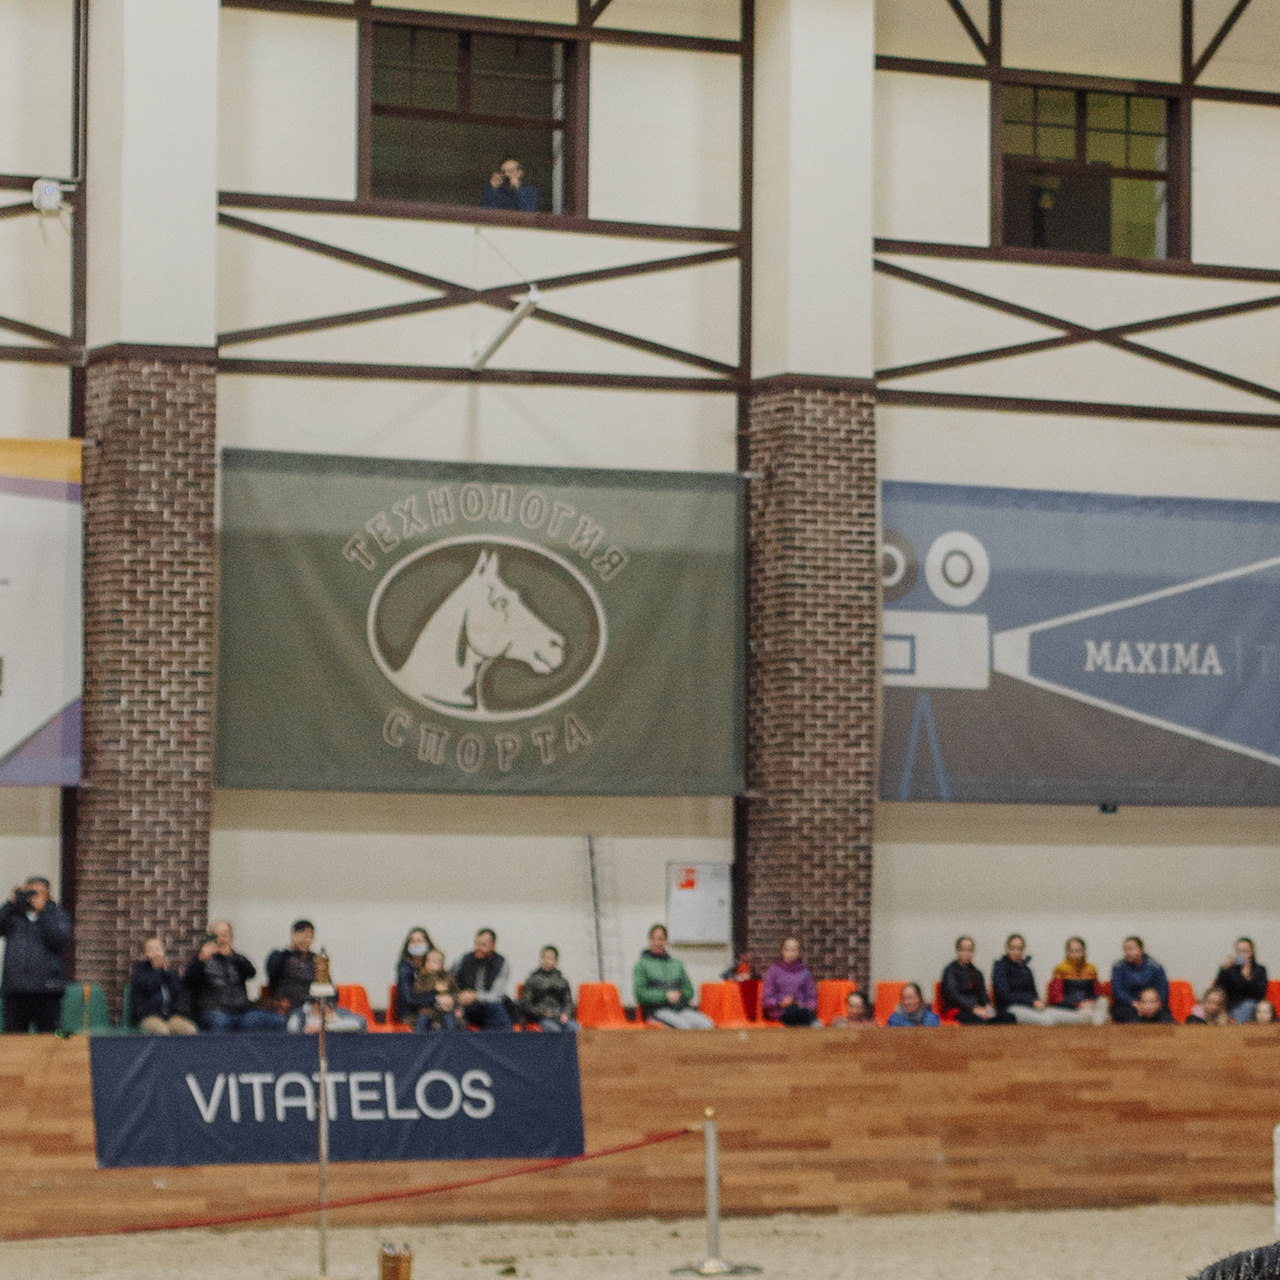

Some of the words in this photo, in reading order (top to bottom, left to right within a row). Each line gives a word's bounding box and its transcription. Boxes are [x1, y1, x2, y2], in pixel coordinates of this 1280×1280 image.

[342, 482, 630, 582] ТЕХНОЛОГИЯ
[1085, 640, 1223, 675] MAXIMA
[383, 708, 594, 773] СПОРТА
[185, 1069, 495, 1123] VITATELOS
